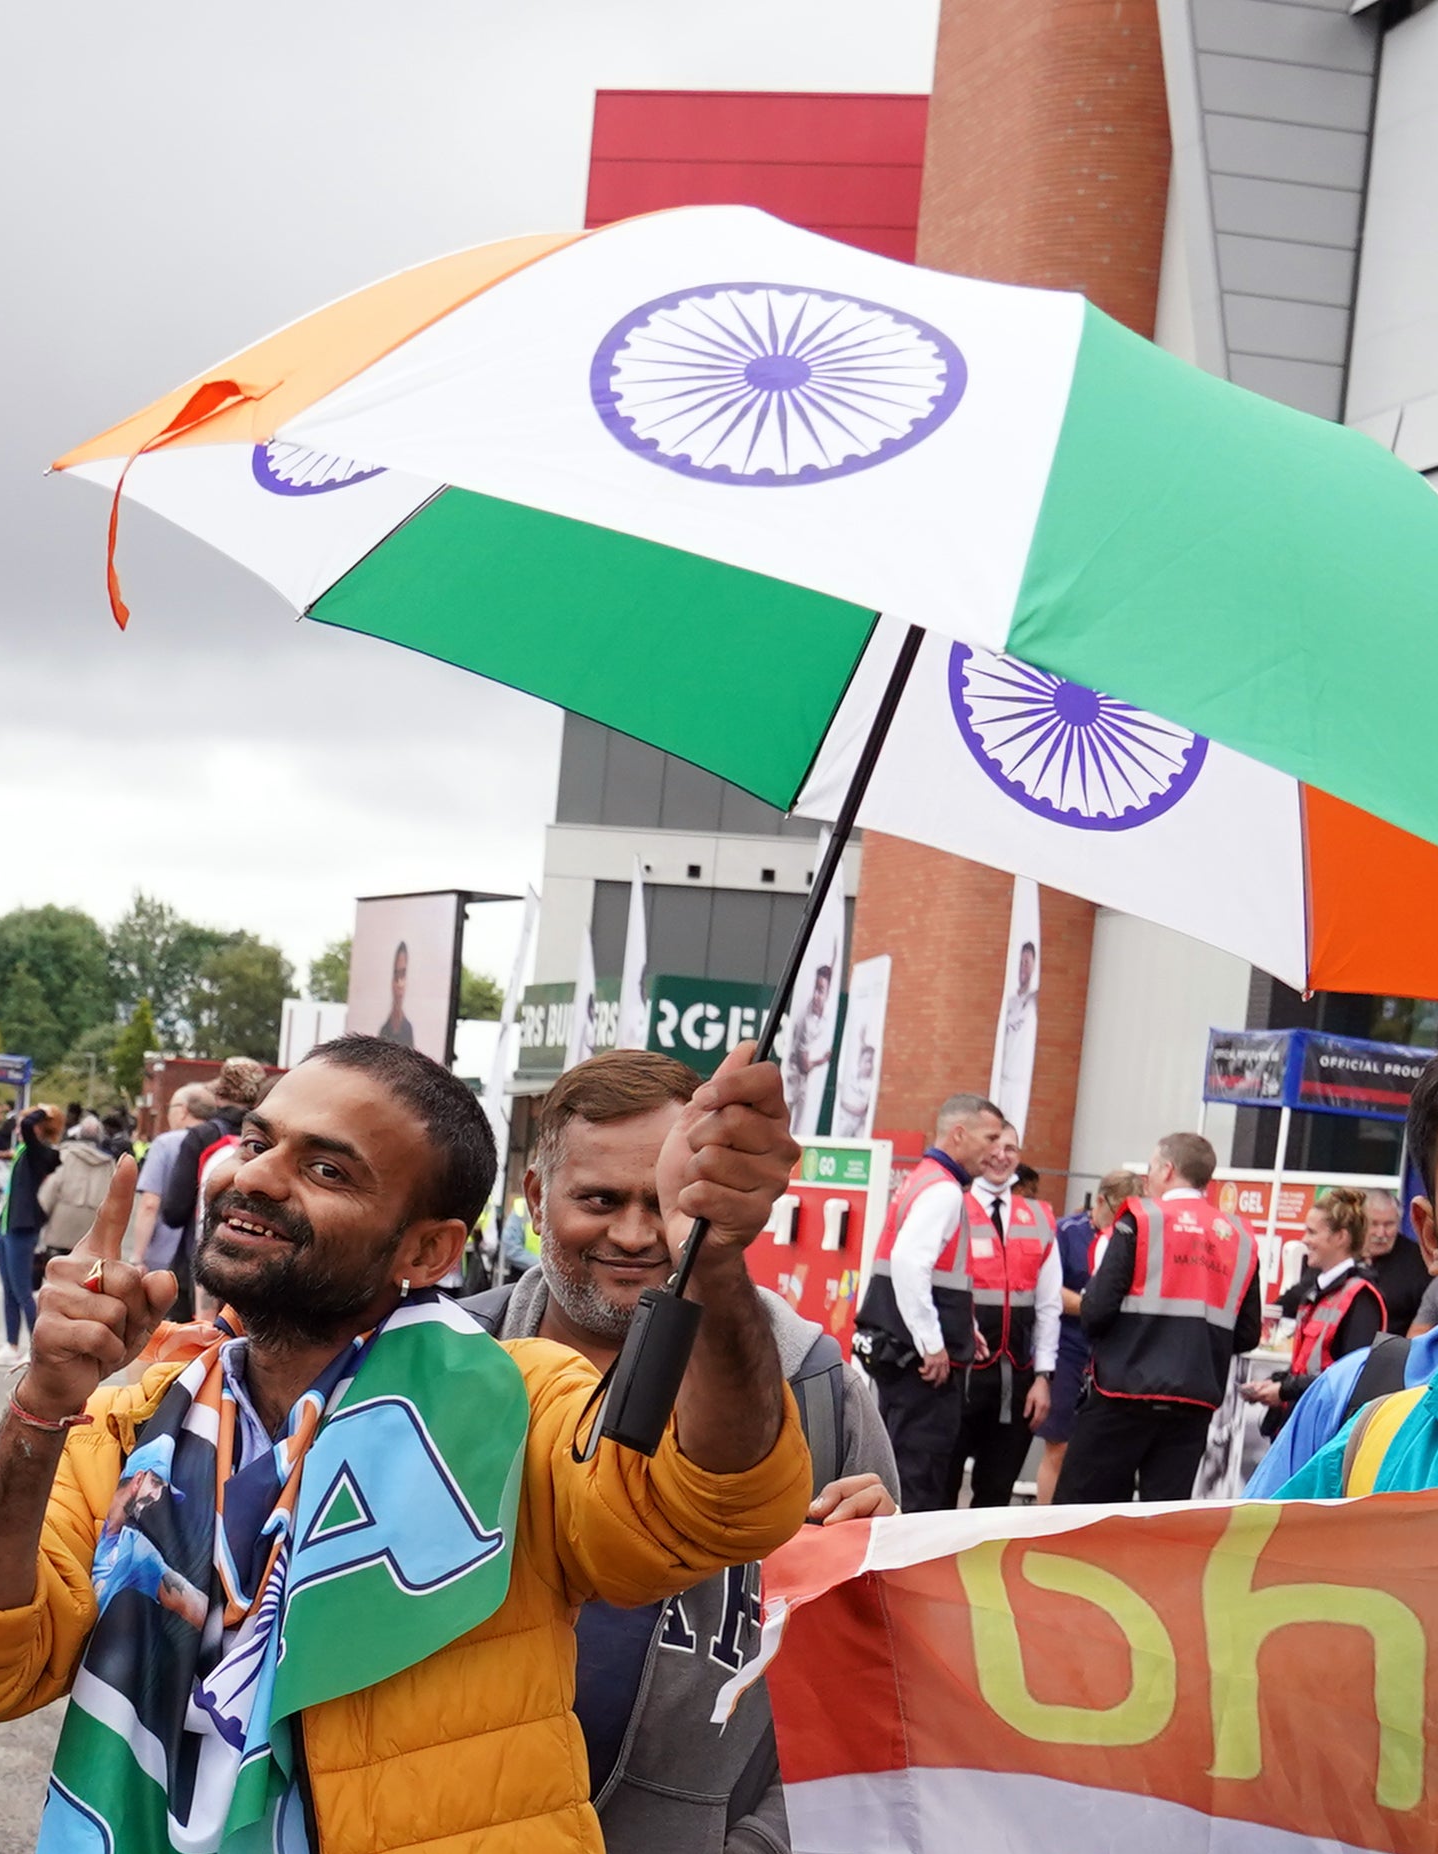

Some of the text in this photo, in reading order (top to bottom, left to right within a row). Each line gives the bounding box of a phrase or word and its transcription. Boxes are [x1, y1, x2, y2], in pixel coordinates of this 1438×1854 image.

[1319, 1055, 1379, 1074] OFFICIAL
[819, 1156, 837, 1177] GO
[1238, 1190, 1264, 1214] GEL
